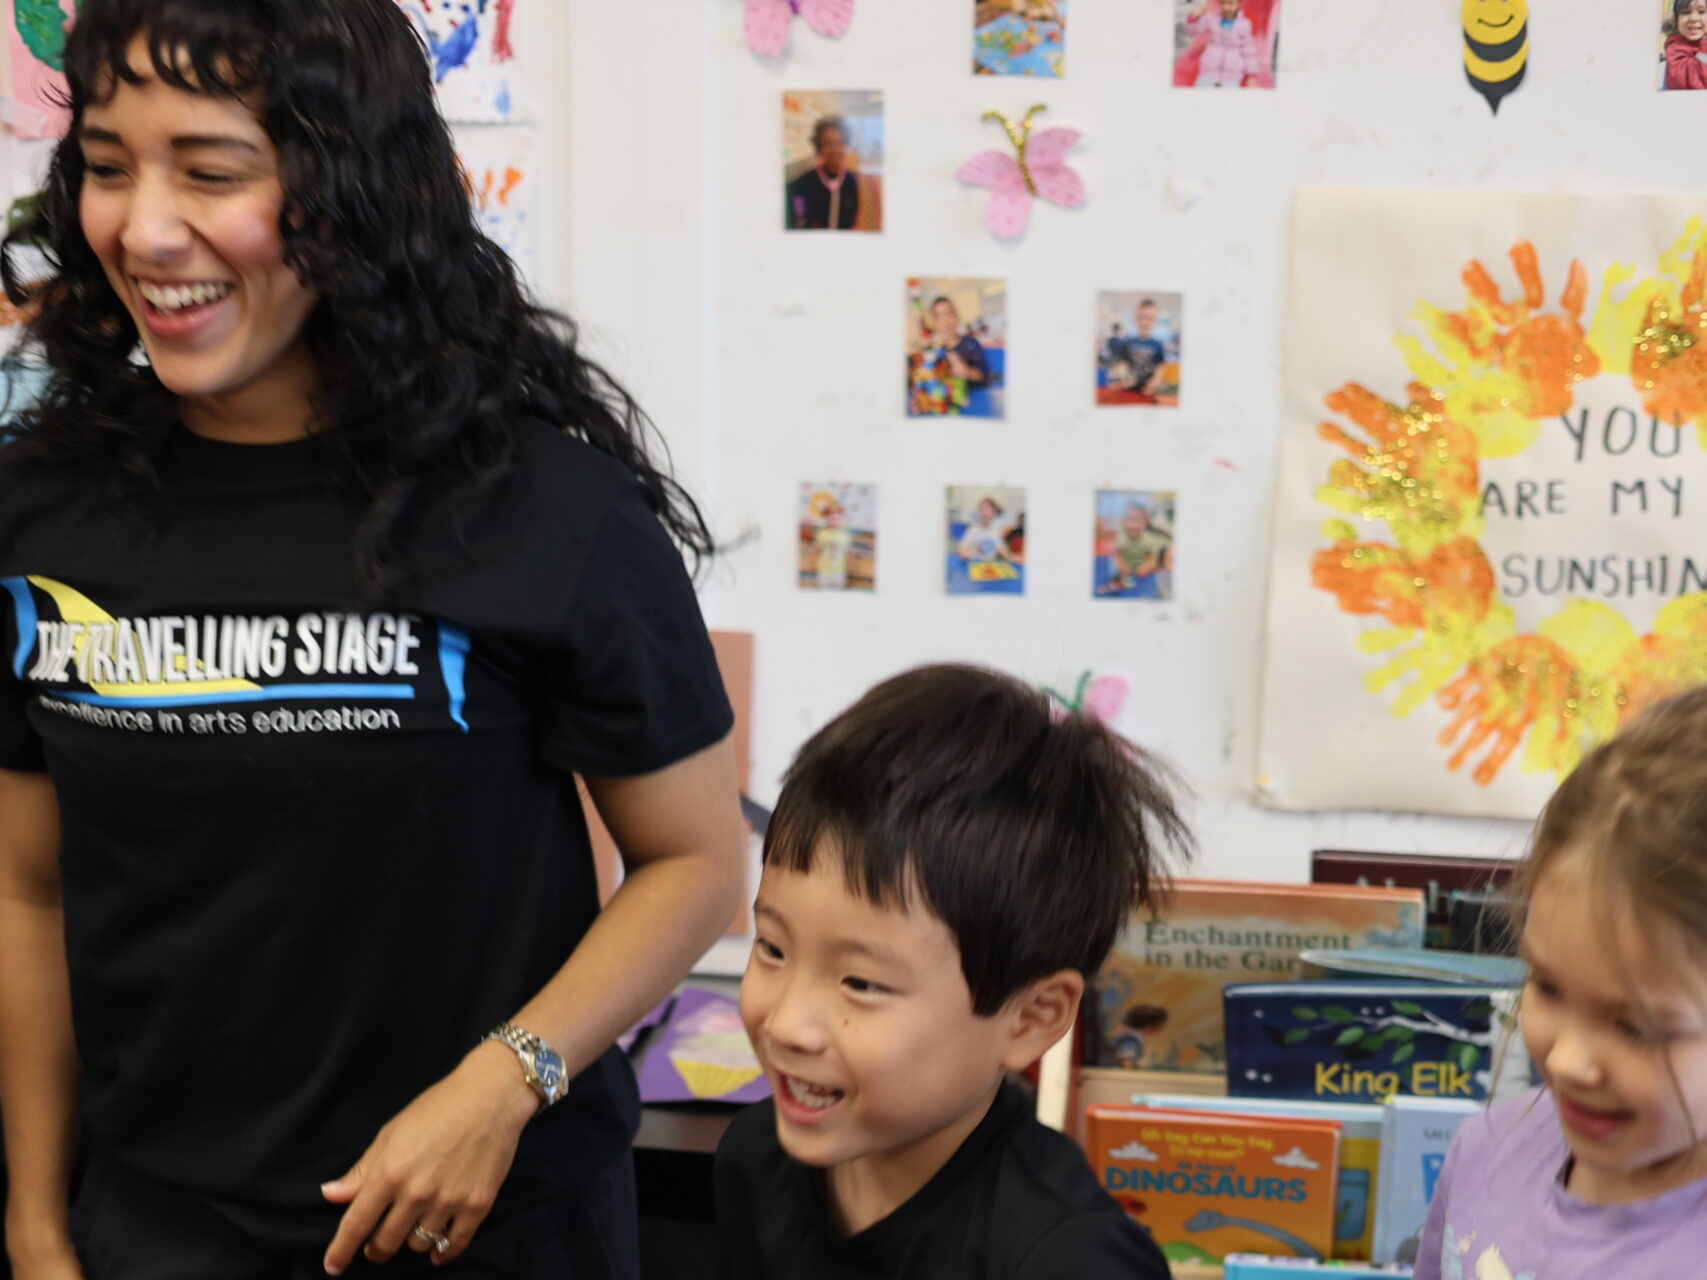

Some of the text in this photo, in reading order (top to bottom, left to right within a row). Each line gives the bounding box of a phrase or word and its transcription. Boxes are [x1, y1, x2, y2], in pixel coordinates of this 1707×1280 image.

[1561, 405, 1681, 463] YOU
[1476, 476, 1683, 519] ARE MY
[28, 612, 422, 684] THE TRAVELLING STAGE
[158, 708, 184, 734] in
[188, 709, 247, 735] arts
[252, 705, 401, 734] education
[1145, 921, 1352, 950] Enchantment
[1145, 950, 1172, 968] in
[1184, 948, 1230, 971] the
[1315, 1061, 1473, 1104] King Elk
[1105, 1166, 1308, 1203] DINOSAURS
